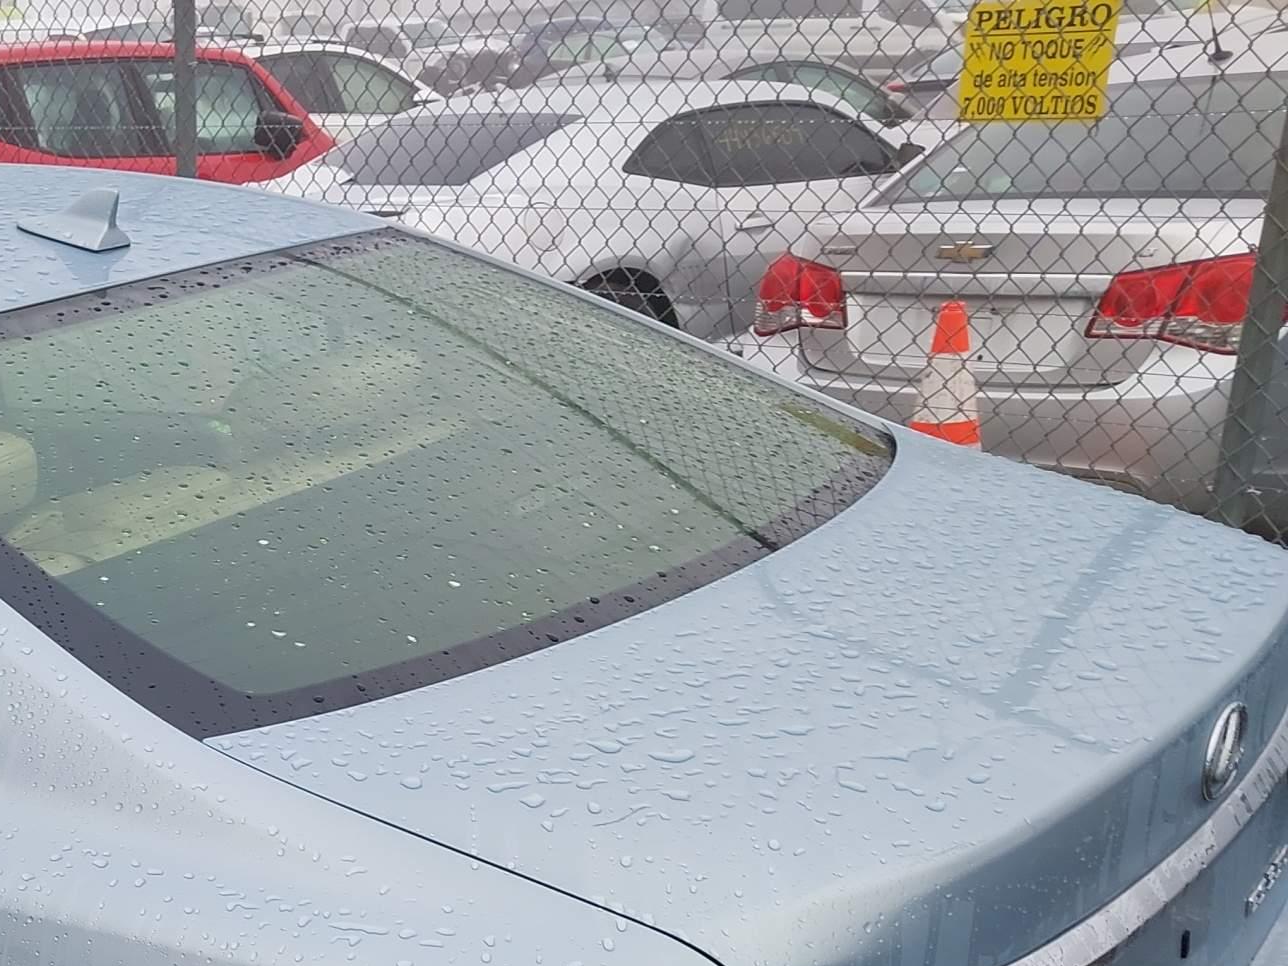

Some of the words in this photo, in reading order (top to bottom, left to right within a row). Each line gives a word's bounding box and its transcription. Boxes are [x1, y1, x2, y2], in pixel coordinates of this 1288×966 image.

[974, 3, 1112, 31] PELIGRO
[989, 41, 1014, 61] NO
[1021, 38, 1085, 60] TOQUE
[973, 70, 992, 88] de
[999, 69, 1026, 88] alta
[1033, 67, 1096, 88] tension
[1012, 94, 1098, 116] VOLTIOS
